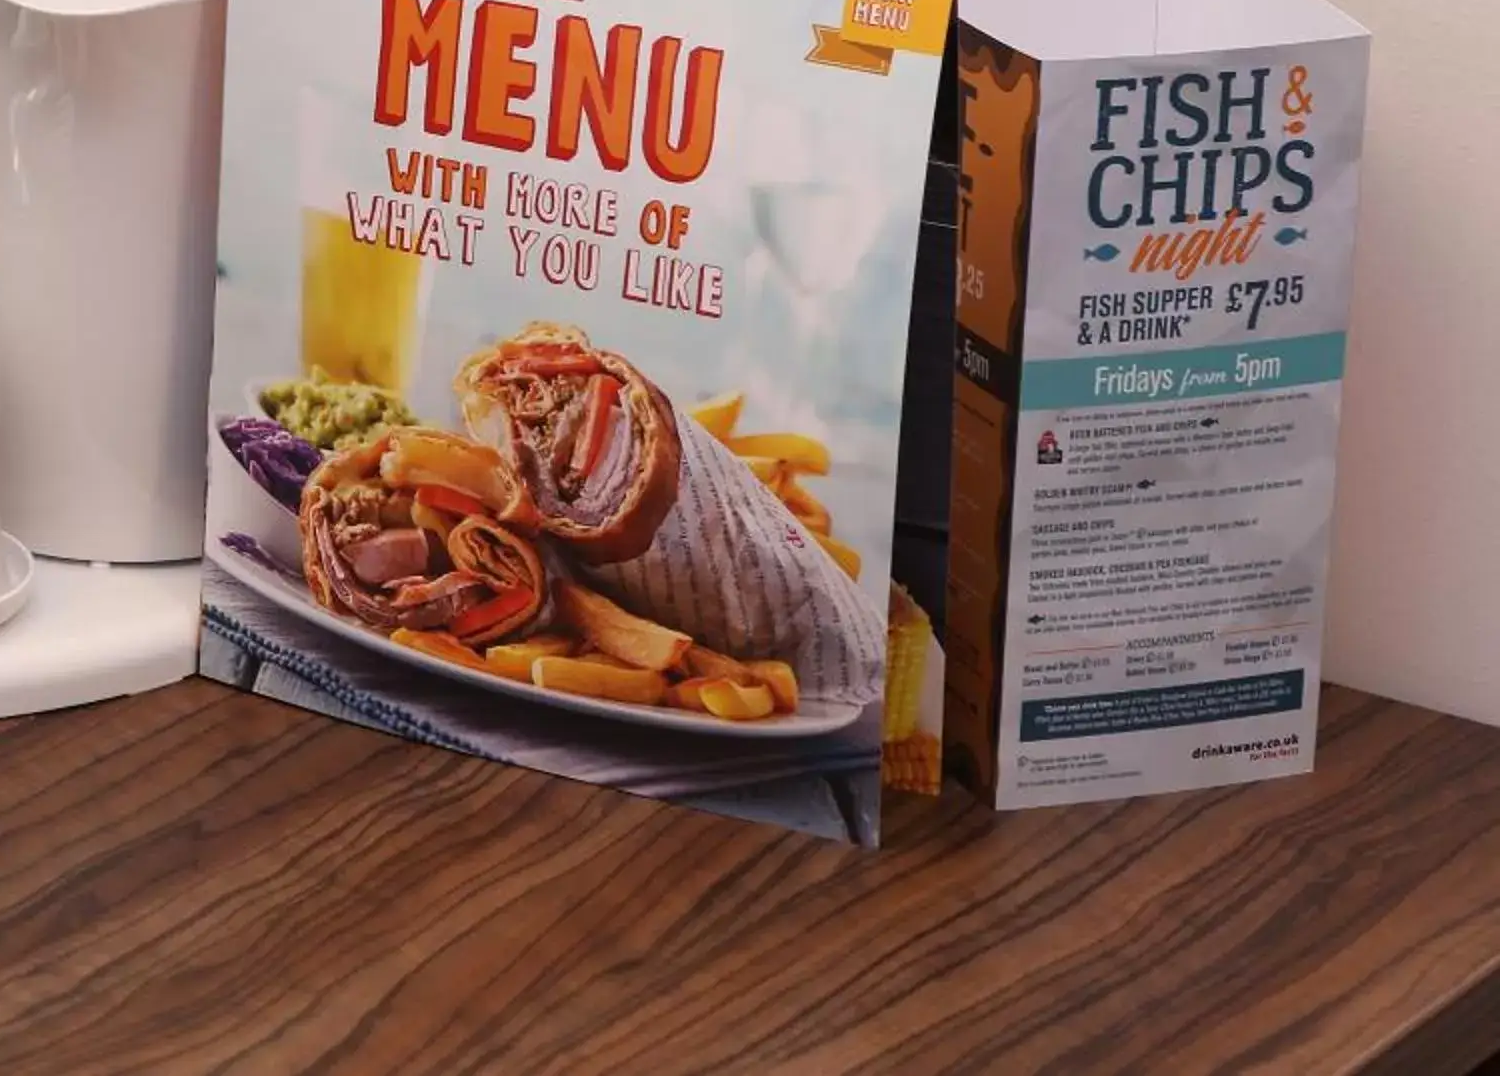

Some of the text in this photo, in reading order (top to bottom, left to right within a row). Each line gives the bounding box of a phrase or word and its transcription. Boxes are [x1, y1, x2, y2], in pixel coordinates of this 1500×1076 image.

[852, 0, 910, 32] MENU
[1090, 65, 1313, 151] FISH &
[386, 147, 691, 250] WITH MORE OF
[1087, 139, 1315, 228] CHIPS
[347, 192, 724, 319] WHAT YOU LIKE
[1128, 209, 1265, 281] night
[1077, 321, 1093, 346] &
[1098, 322, 1112, 344] A
[1079, 274, 1305, 331] FISH SUPPER £7.95
[1093, 353, 1281, 399] Fridays from 5pm
[1191, 733, 1299, 759] drinkaware.co.uk
